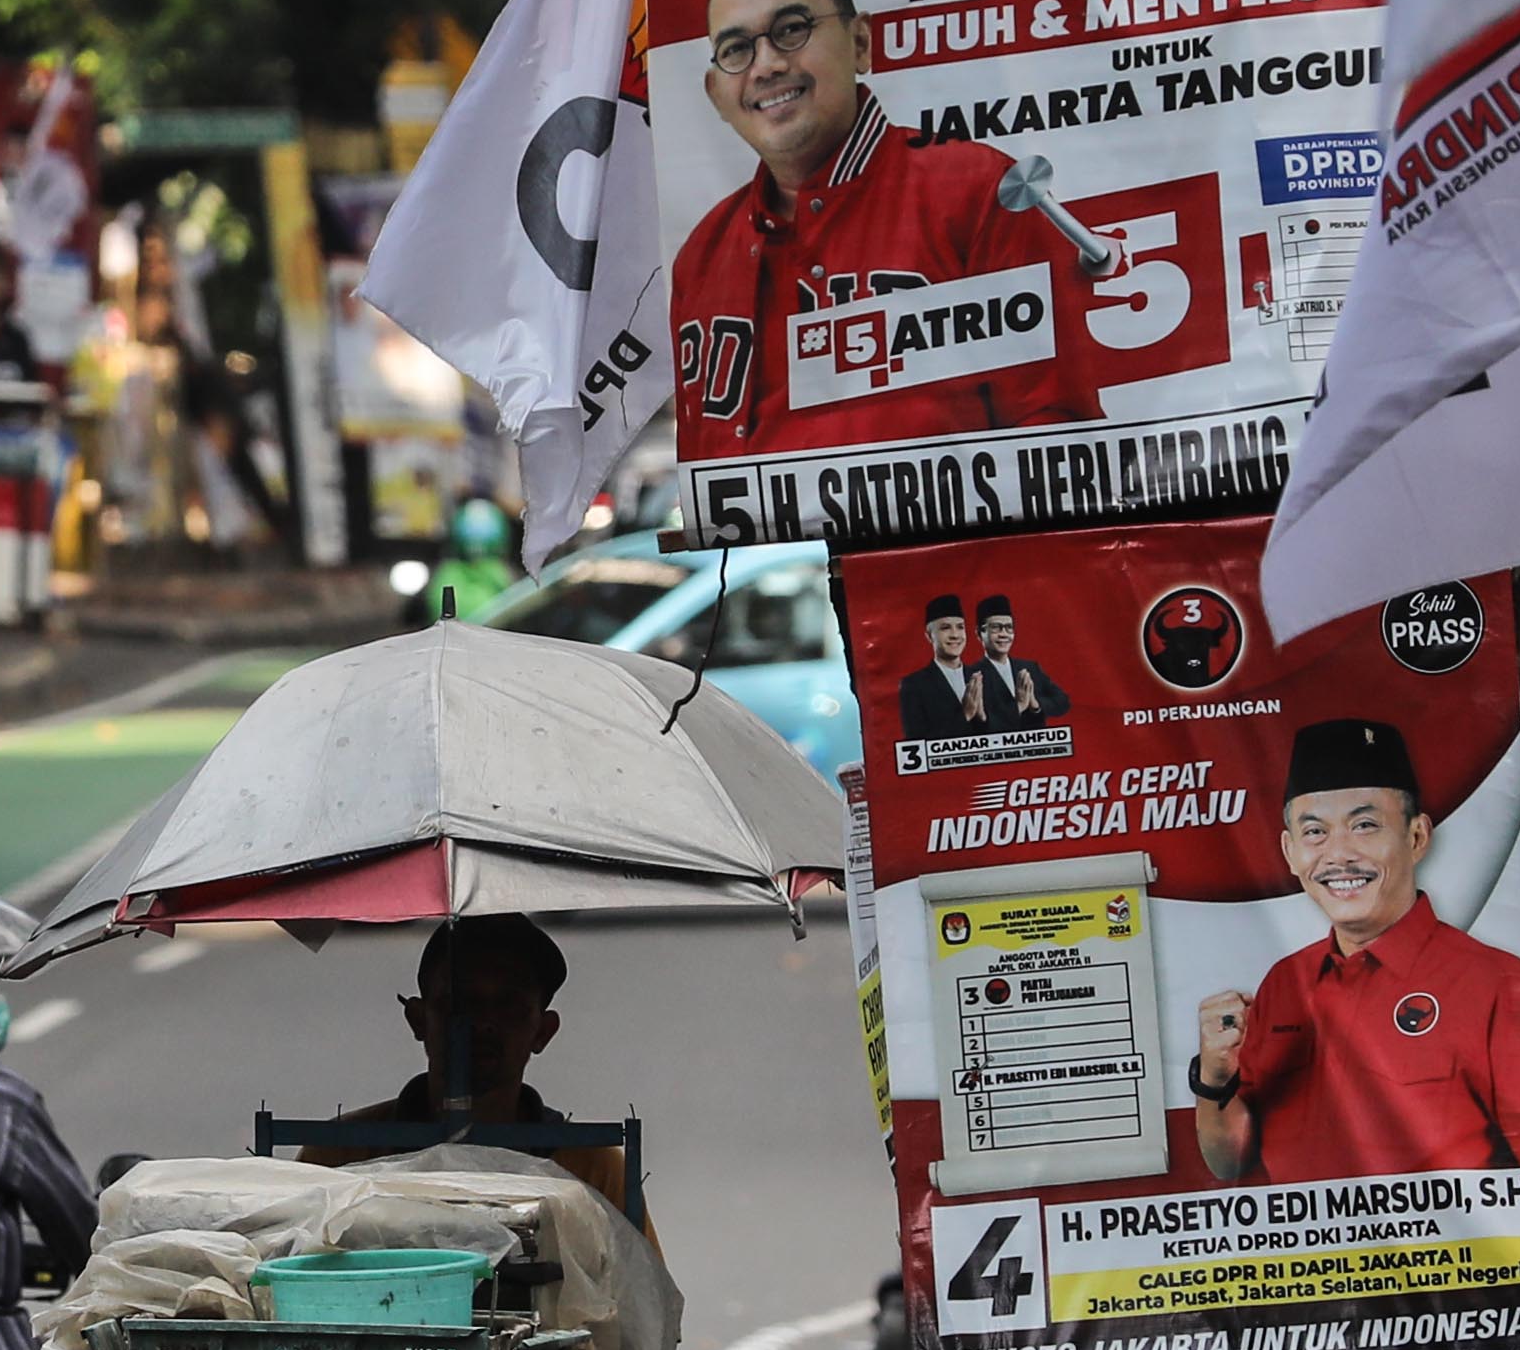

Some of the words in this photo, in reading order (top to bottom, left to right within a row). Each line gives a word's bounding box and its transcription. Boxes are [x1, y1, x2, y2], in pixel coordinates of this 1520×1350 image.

[882, 0, 1016, 63] UTUH
[1030, 0, 1070, 41] &
[1112, 34, 1212, 72] UNTUK
[908, 74, 1139, 147] JAKARTA
[1284, 149, 1383, 178] DPRD
[1288, 178, 1355, 192] PROVINSI
[1085, 211, 1191, 351] 5
[770, 473, 817, 543] H.
[821, 451, 961, 540] SATRIO
[975, 451, 1012, 524] S.
[1017, 414, 1289, 519] HERLAMBANG
[708, 478, 755, 549] 5
[1183, 600, 1202, 623] 3
[1408, 593, 1457, 617] Sohib
[1391, 617, 1476, 648] PRASS
[1123, 707, 1152, 726] PDI
[1158, 697, 1281, 723] PERJUANGAN
[901, 745, 922, 771] 3
[930, 736, 989, 754] GANJAR
[1002, 729, 1068, 746] MAHFUD
[1008, 768, 1110, 807] GERAK
[1119, 760, 1213, 798] CEPAT
[927, 792, 1128, 853] INDONESIA
[1141, 788, 1247, 833] MAJU
[988, 963, 1015, 974] DAPIL
[1038, 957, 1083, 970] JAKARTA
[999, 951, 1046, 964] ANGGOTA
[1061, 1211, 1093, 1243] H.
[1100, 1194, 1259, 1240] PRASETYO
[1266, 1190, 1318, 1225] EDI
[1326, 1178, 1472, 1218] MARSUDI,
[1162, 1236, 1232, 1260] KETUA
[1237, 1230, 1301, 1253] DPRD
[1306, 1227, 1341, 1248] DKI
[1346, 1218, 1441, 1244] JAKARTA
[946, 1215, 1034, 1317] 4
[1138, 1267, 1207, 1290] CALEG
[1212, 1263, 1258, 1285] DPR
[1262, 1260, 1286, 1281] RI
[1291, 1257, 1355, 1279] DAPIL
[1360, 1249, 1454, 1274] JAKARTA
[1088, 1293, 1162, 1315] Jakarta
[1169, 1288, 1232, 1312] Pusat,
[1238, 1279, 1316, 1303] Jakarta
[1321, 1271, 1403, 1298] Selatan,
[1406, 1268, 1453, 1290] Luar
